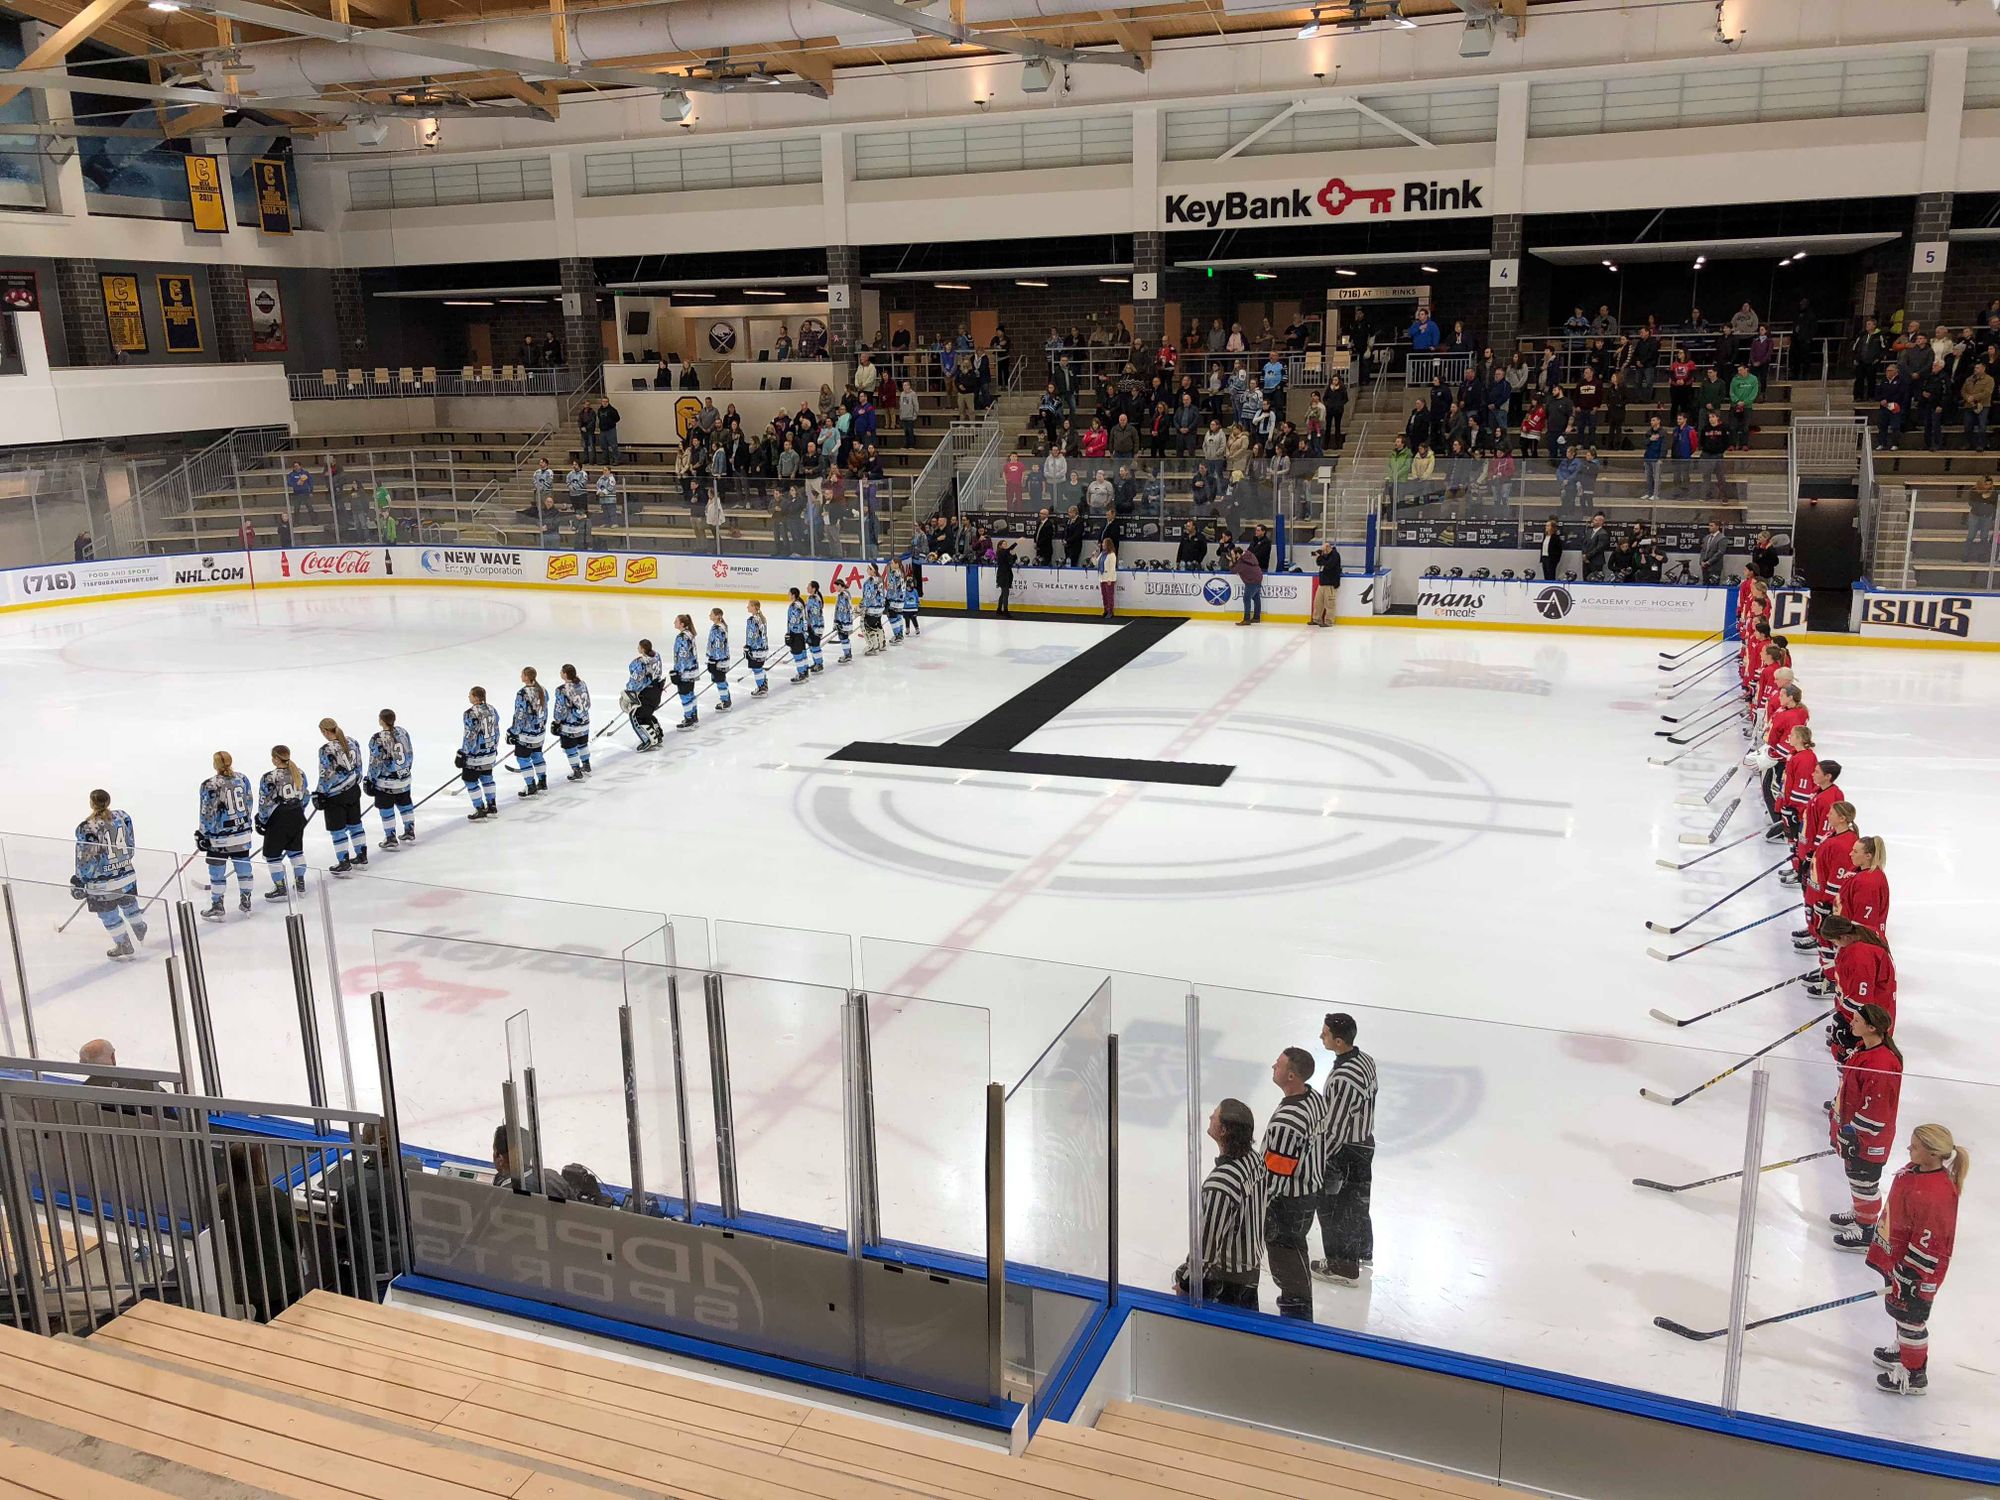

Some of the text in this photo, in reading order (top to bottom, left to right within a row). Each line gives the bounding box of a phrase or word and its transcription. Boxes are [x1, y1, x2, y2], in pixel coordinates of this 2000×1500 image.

[1165, 179, 1483, 227] KeyBank Rink
[1925, 250, 1936, 263] 5
[1499, 266, 1509, 280] 4
[1141, 280, 1149, 291] 3
[835, 291, 842, 302] 2
[1338, 289, 1361, 298] (716)
[1392, 288, 1416, 296] RINKS
[444, 551, 521, 565] NEW WAVE
[128, 568, 151, 576] SPORT
[175, 567, 245, 584] NHL.COM
[475, 565, 523, 576] Corporation
[22, 571, 76, 595] (716)
[1145, 581, 1202, 597] BUFFALO
[1259, 584, 1298, 599] ABRES
[1651, 600, 1695, 608] HOCKEY
[226, 786, 246, 815] 16
[104, 826, 129, 860] 14
[1863, 906, 1873, 919] 7
[1858, 982, 1868, 996] 6
[1920, 1228, 1932, 1248] 2
